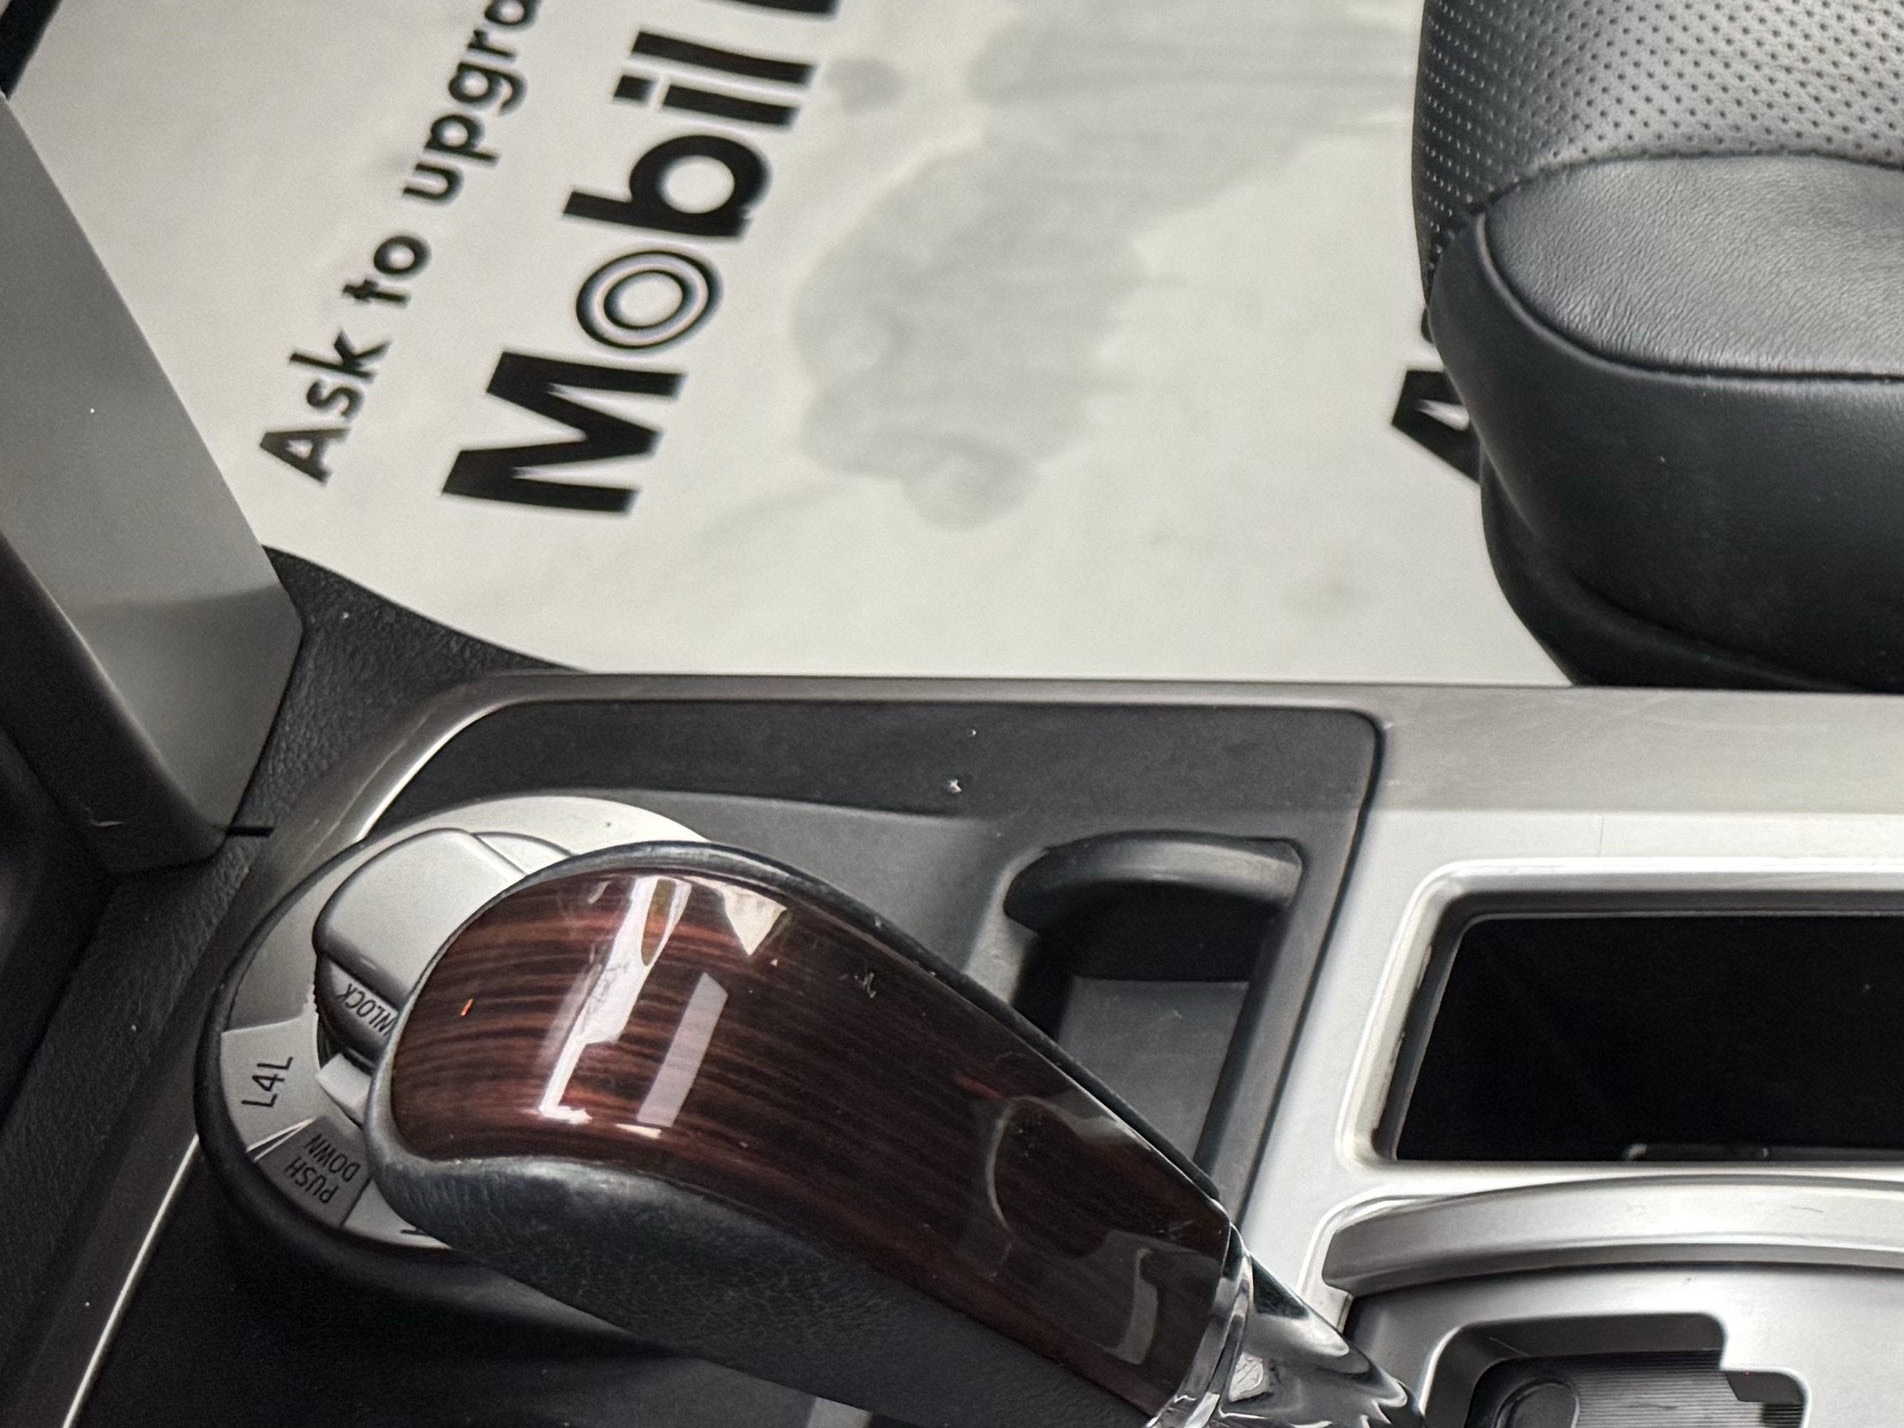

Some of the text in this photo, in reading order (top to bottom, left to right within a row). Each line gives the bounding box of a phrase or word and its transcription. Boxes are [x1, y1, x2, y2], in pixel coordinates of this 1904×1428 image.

[441, 30, 818, 517] Mobil
[259, 331, 392, 486] Ask
[341, 234, 432, 309] to
[240, 1056, 293, 1108] L4L
[284, 1158, 340, 1205] PUSH
[304, 1132, 361, 1184] DOWN
